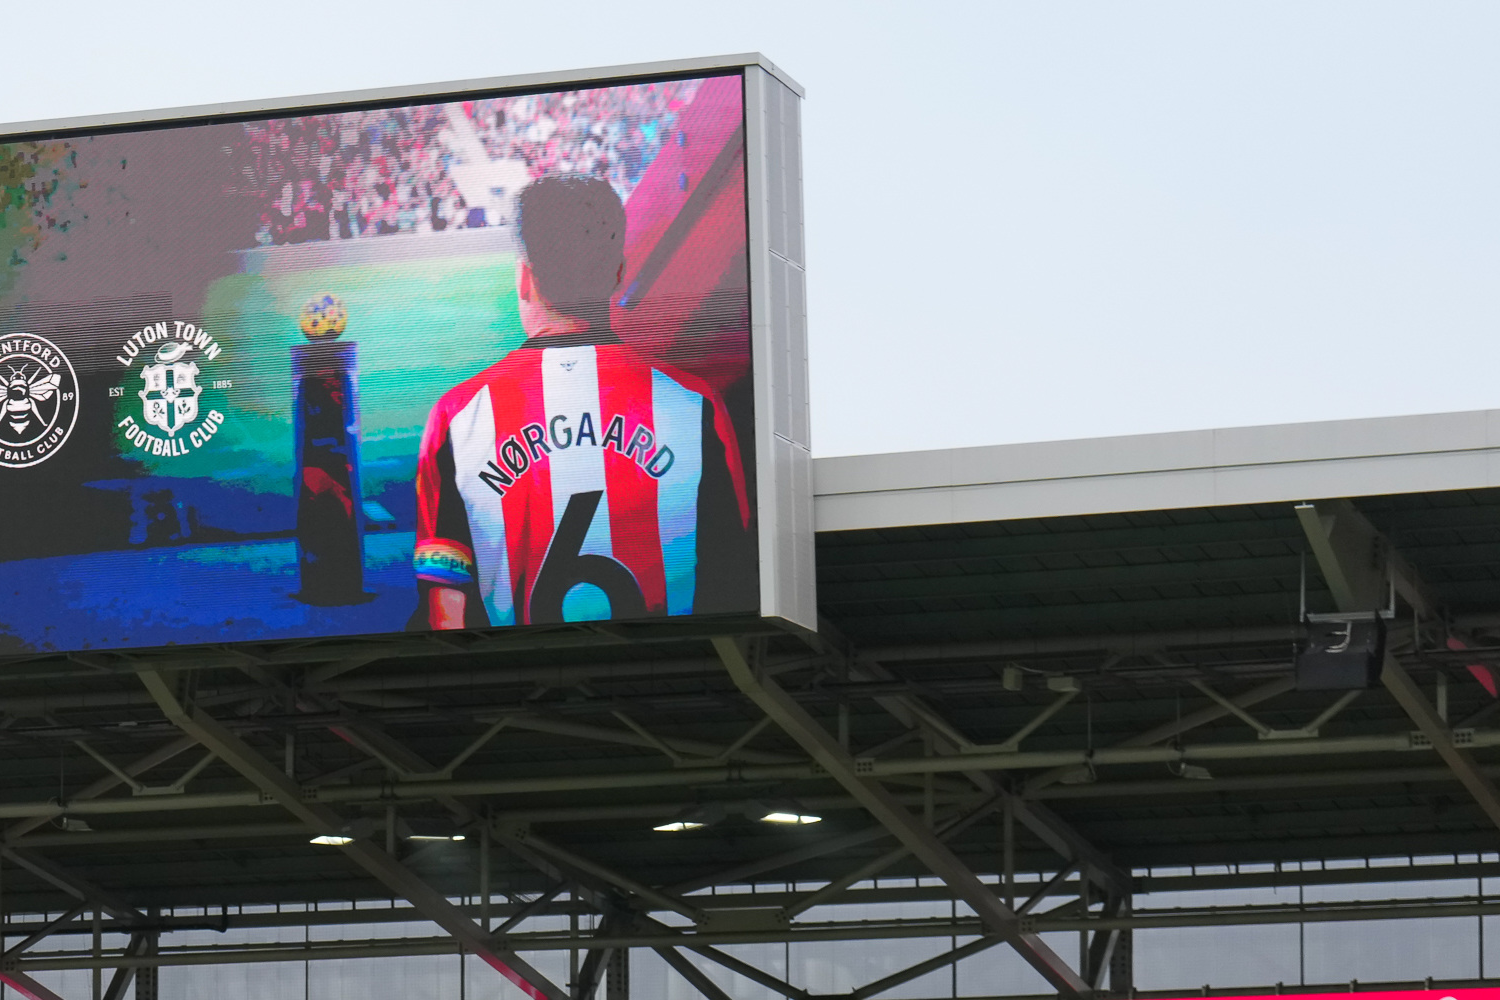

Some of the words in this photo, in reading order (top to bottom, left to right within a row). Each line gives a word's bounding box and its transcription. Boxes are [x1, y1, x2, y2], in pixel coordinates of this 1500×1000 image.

[116, 321, 168, 366] LUTON
[173, 320, 222, 361] TOWN
[62, 392, 74, 401] 89
[109, 387, 125, 397] EST
[212, 380, 232, 389] 1885
[37, 426, 64, 454] CLUB
[118, 415, 190, 457] FOOTBALL
[189, 409, 225, 449] CLUB
[478, 412, 675, 497] NØRGAARD
[529, 490, 649, 622] 6
